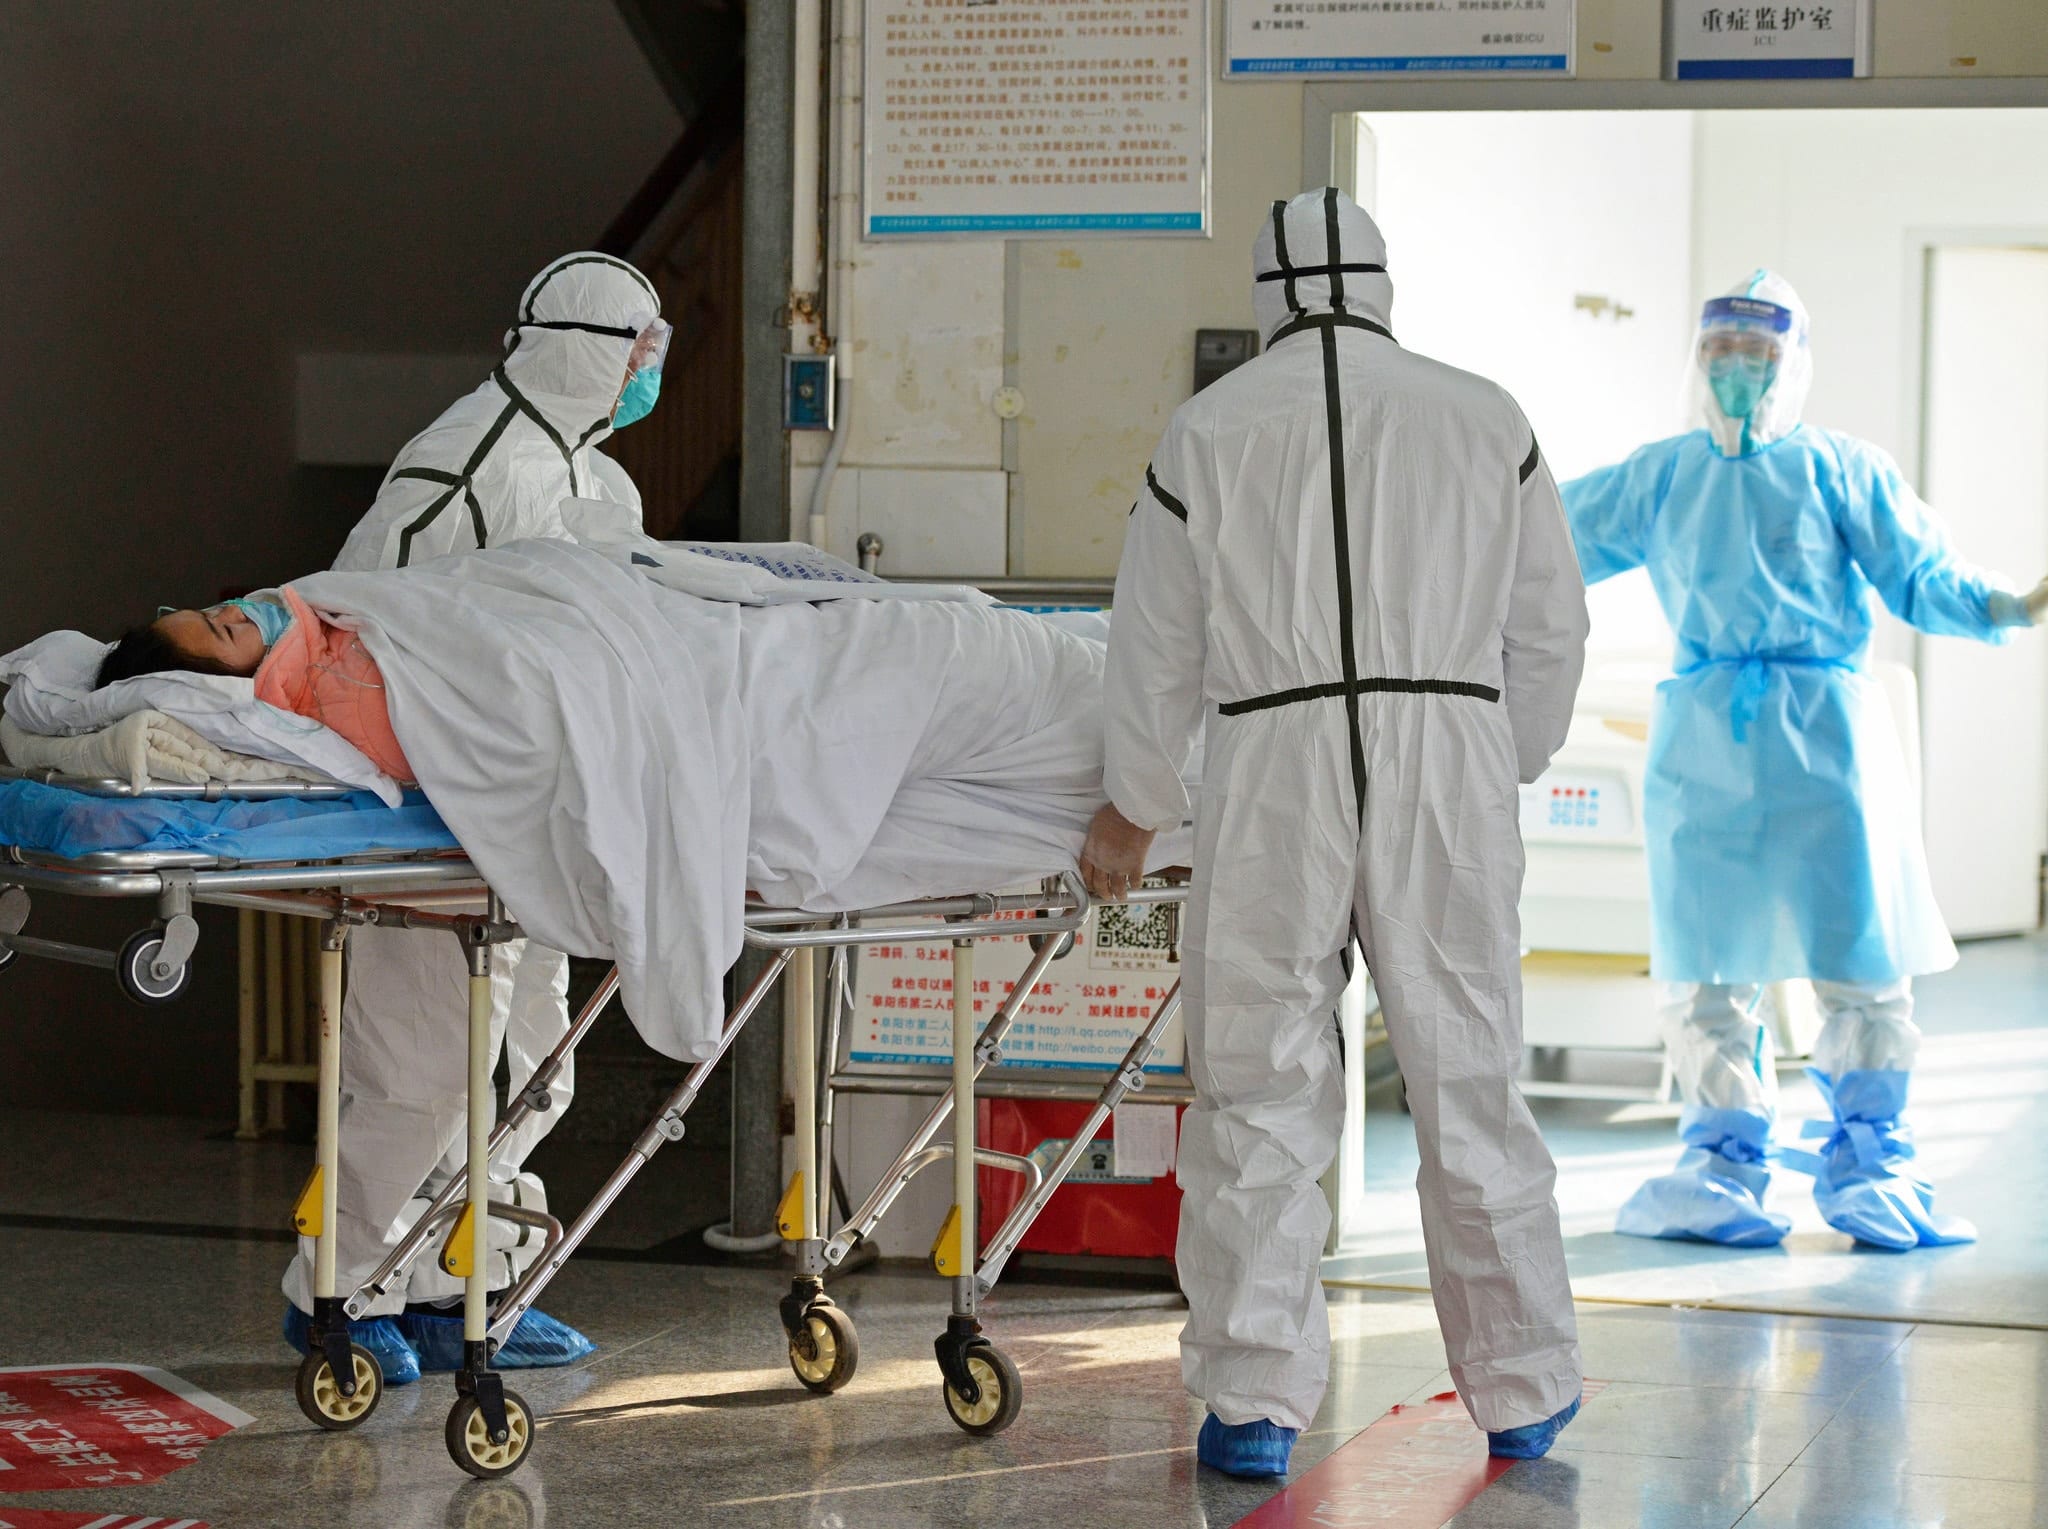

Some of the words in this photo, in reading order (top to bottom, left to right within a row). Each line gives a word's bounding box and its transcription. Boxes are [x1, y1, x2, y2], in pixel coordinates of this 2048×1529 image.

[1702, 7, 1832, 32] 重症监护室
[1753, 35, 1777, 46] ICU
